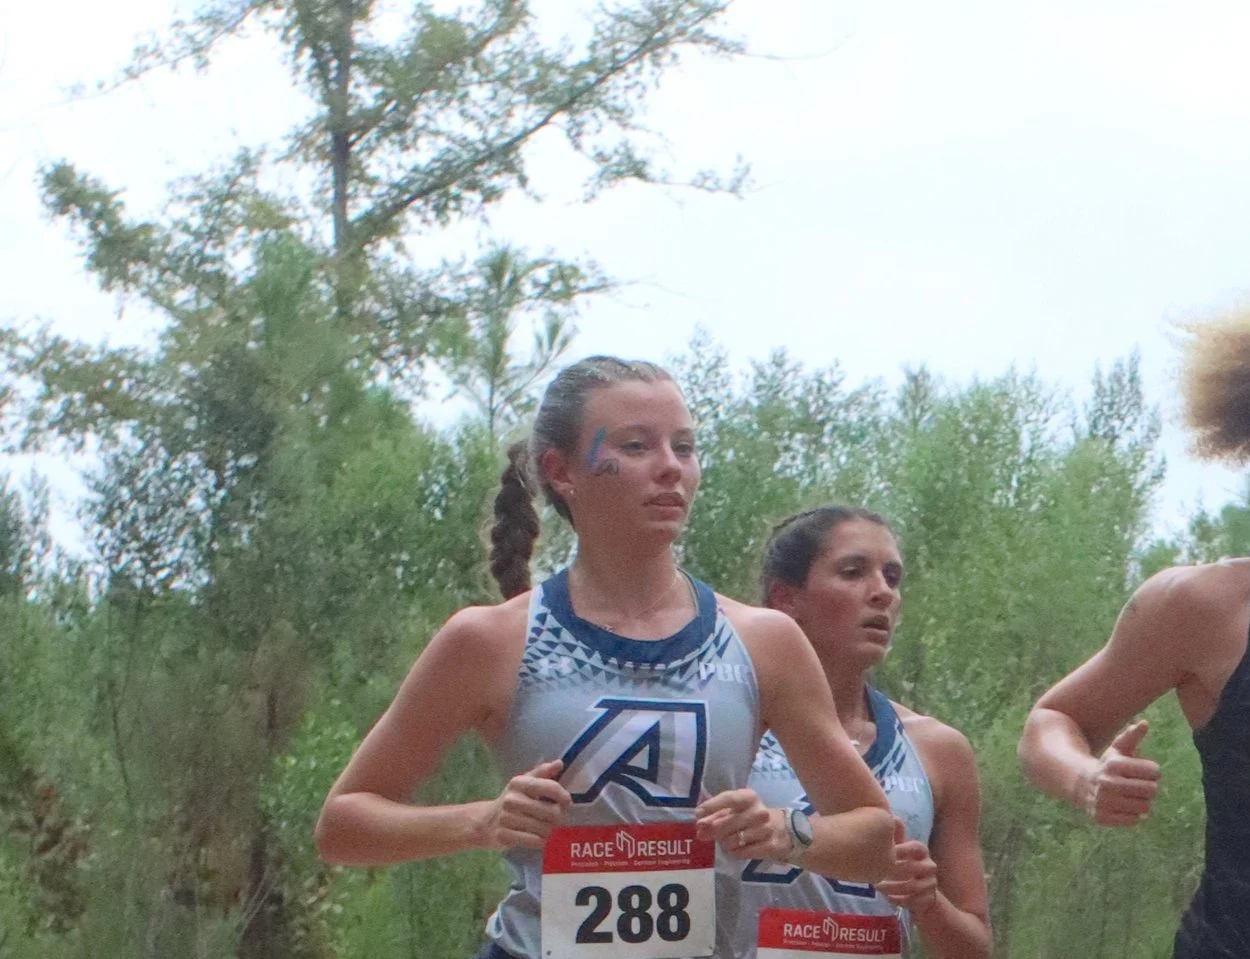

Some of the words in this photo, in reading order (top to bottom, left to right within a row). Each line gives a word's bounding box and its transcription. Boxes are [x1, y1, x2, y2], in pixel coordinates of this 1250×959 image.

[570, 842, 614, 858] RACE
[637, 839, 693, 857] RESULT
[574, 883, 691, 945] 288
[783, 923, 821, 939] RACE
[839, 927, 887, 942] RESULT
